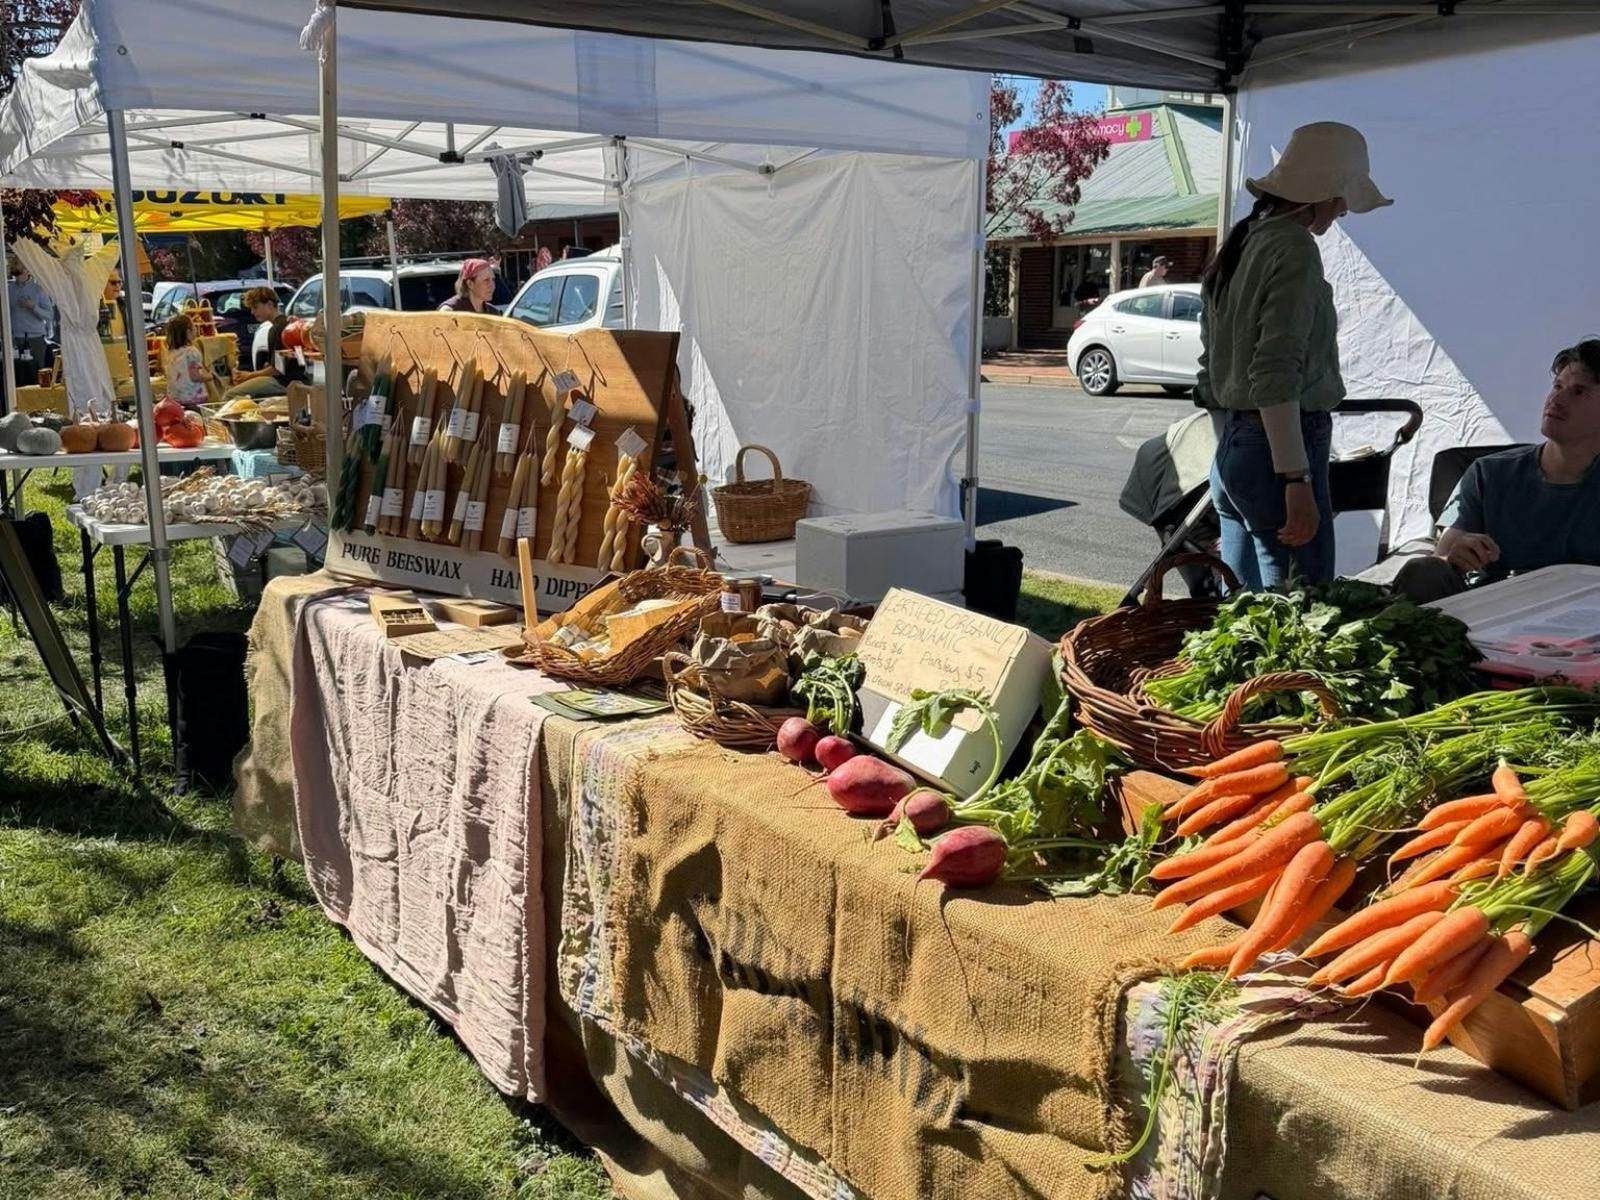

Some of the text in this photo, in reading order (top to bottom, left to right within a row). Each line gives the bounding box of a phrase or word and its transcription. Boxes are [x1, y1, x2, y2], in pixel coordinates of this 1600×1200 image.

[131, 190, 286, 205] UZUKI
[341, 542, 462, 580] PURE BEESWAX
[545, 577, 594, 599] DIPP
[965, 663, 986, 683] $5
